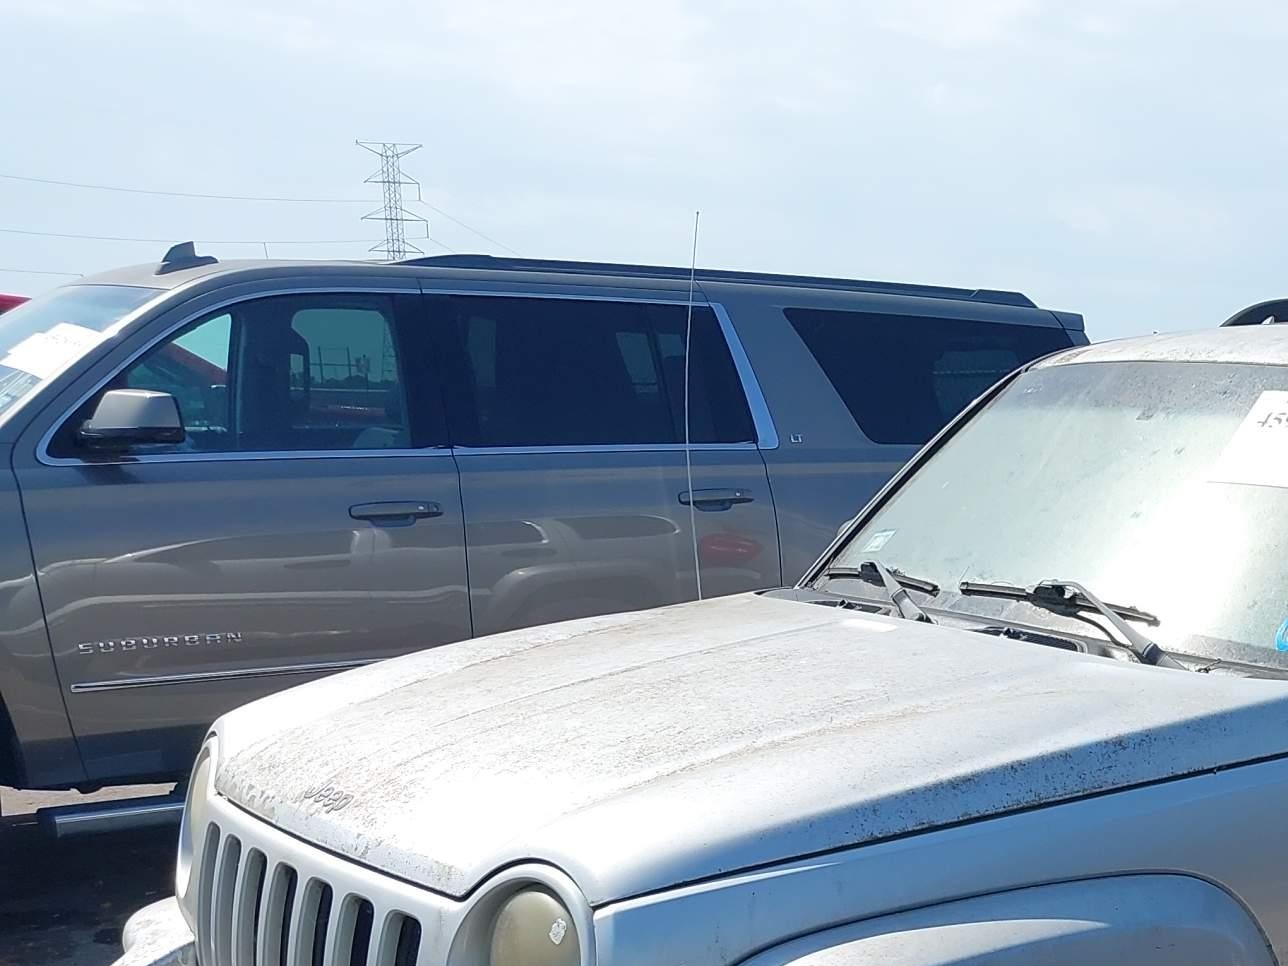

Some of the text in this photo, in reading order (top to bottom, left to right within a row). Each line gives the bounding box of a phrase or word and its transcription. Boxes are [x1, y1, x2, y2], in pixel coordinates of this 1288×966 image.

[790, 433, 804, 443] LT
[78, 632, 242, 654] SUBURBAN
[303, 779, 355, 815] Jeep
